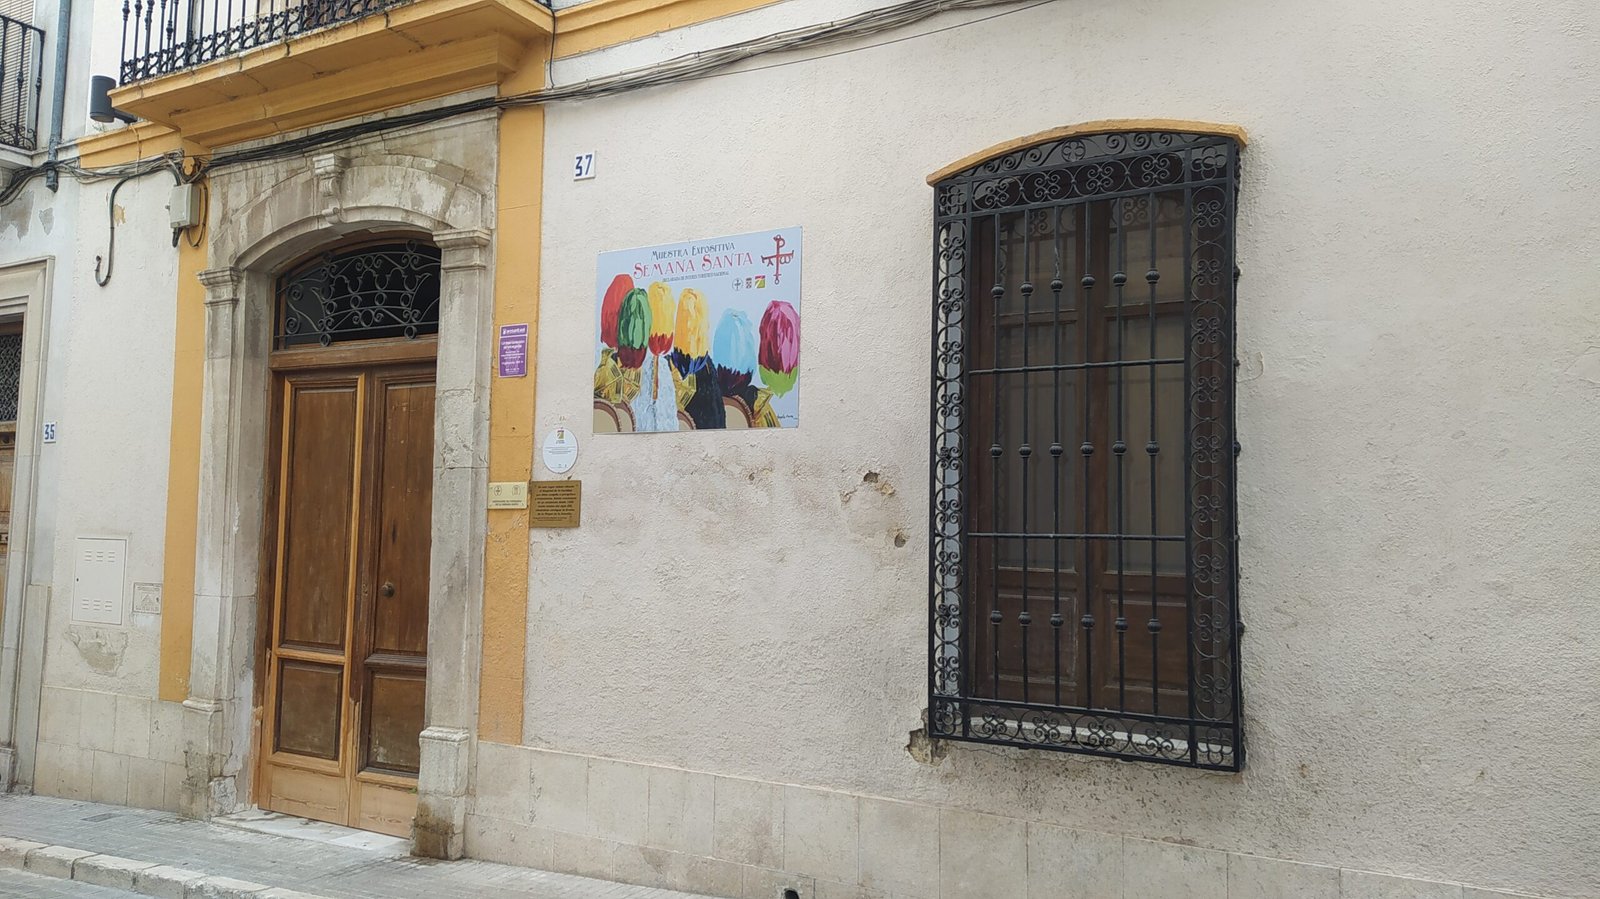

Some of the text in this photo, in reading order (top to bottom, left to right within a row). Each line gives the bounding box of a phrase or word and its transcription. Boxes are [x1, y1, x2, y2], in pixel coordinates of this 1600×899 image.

[575, 154, 593, 177] 37
[650, 242, 736, 261] MUESTRA EXPOSITIVA
[633, 252, 753, 279] SEMANA SANTA
[44, 424, 55, 440] 35
